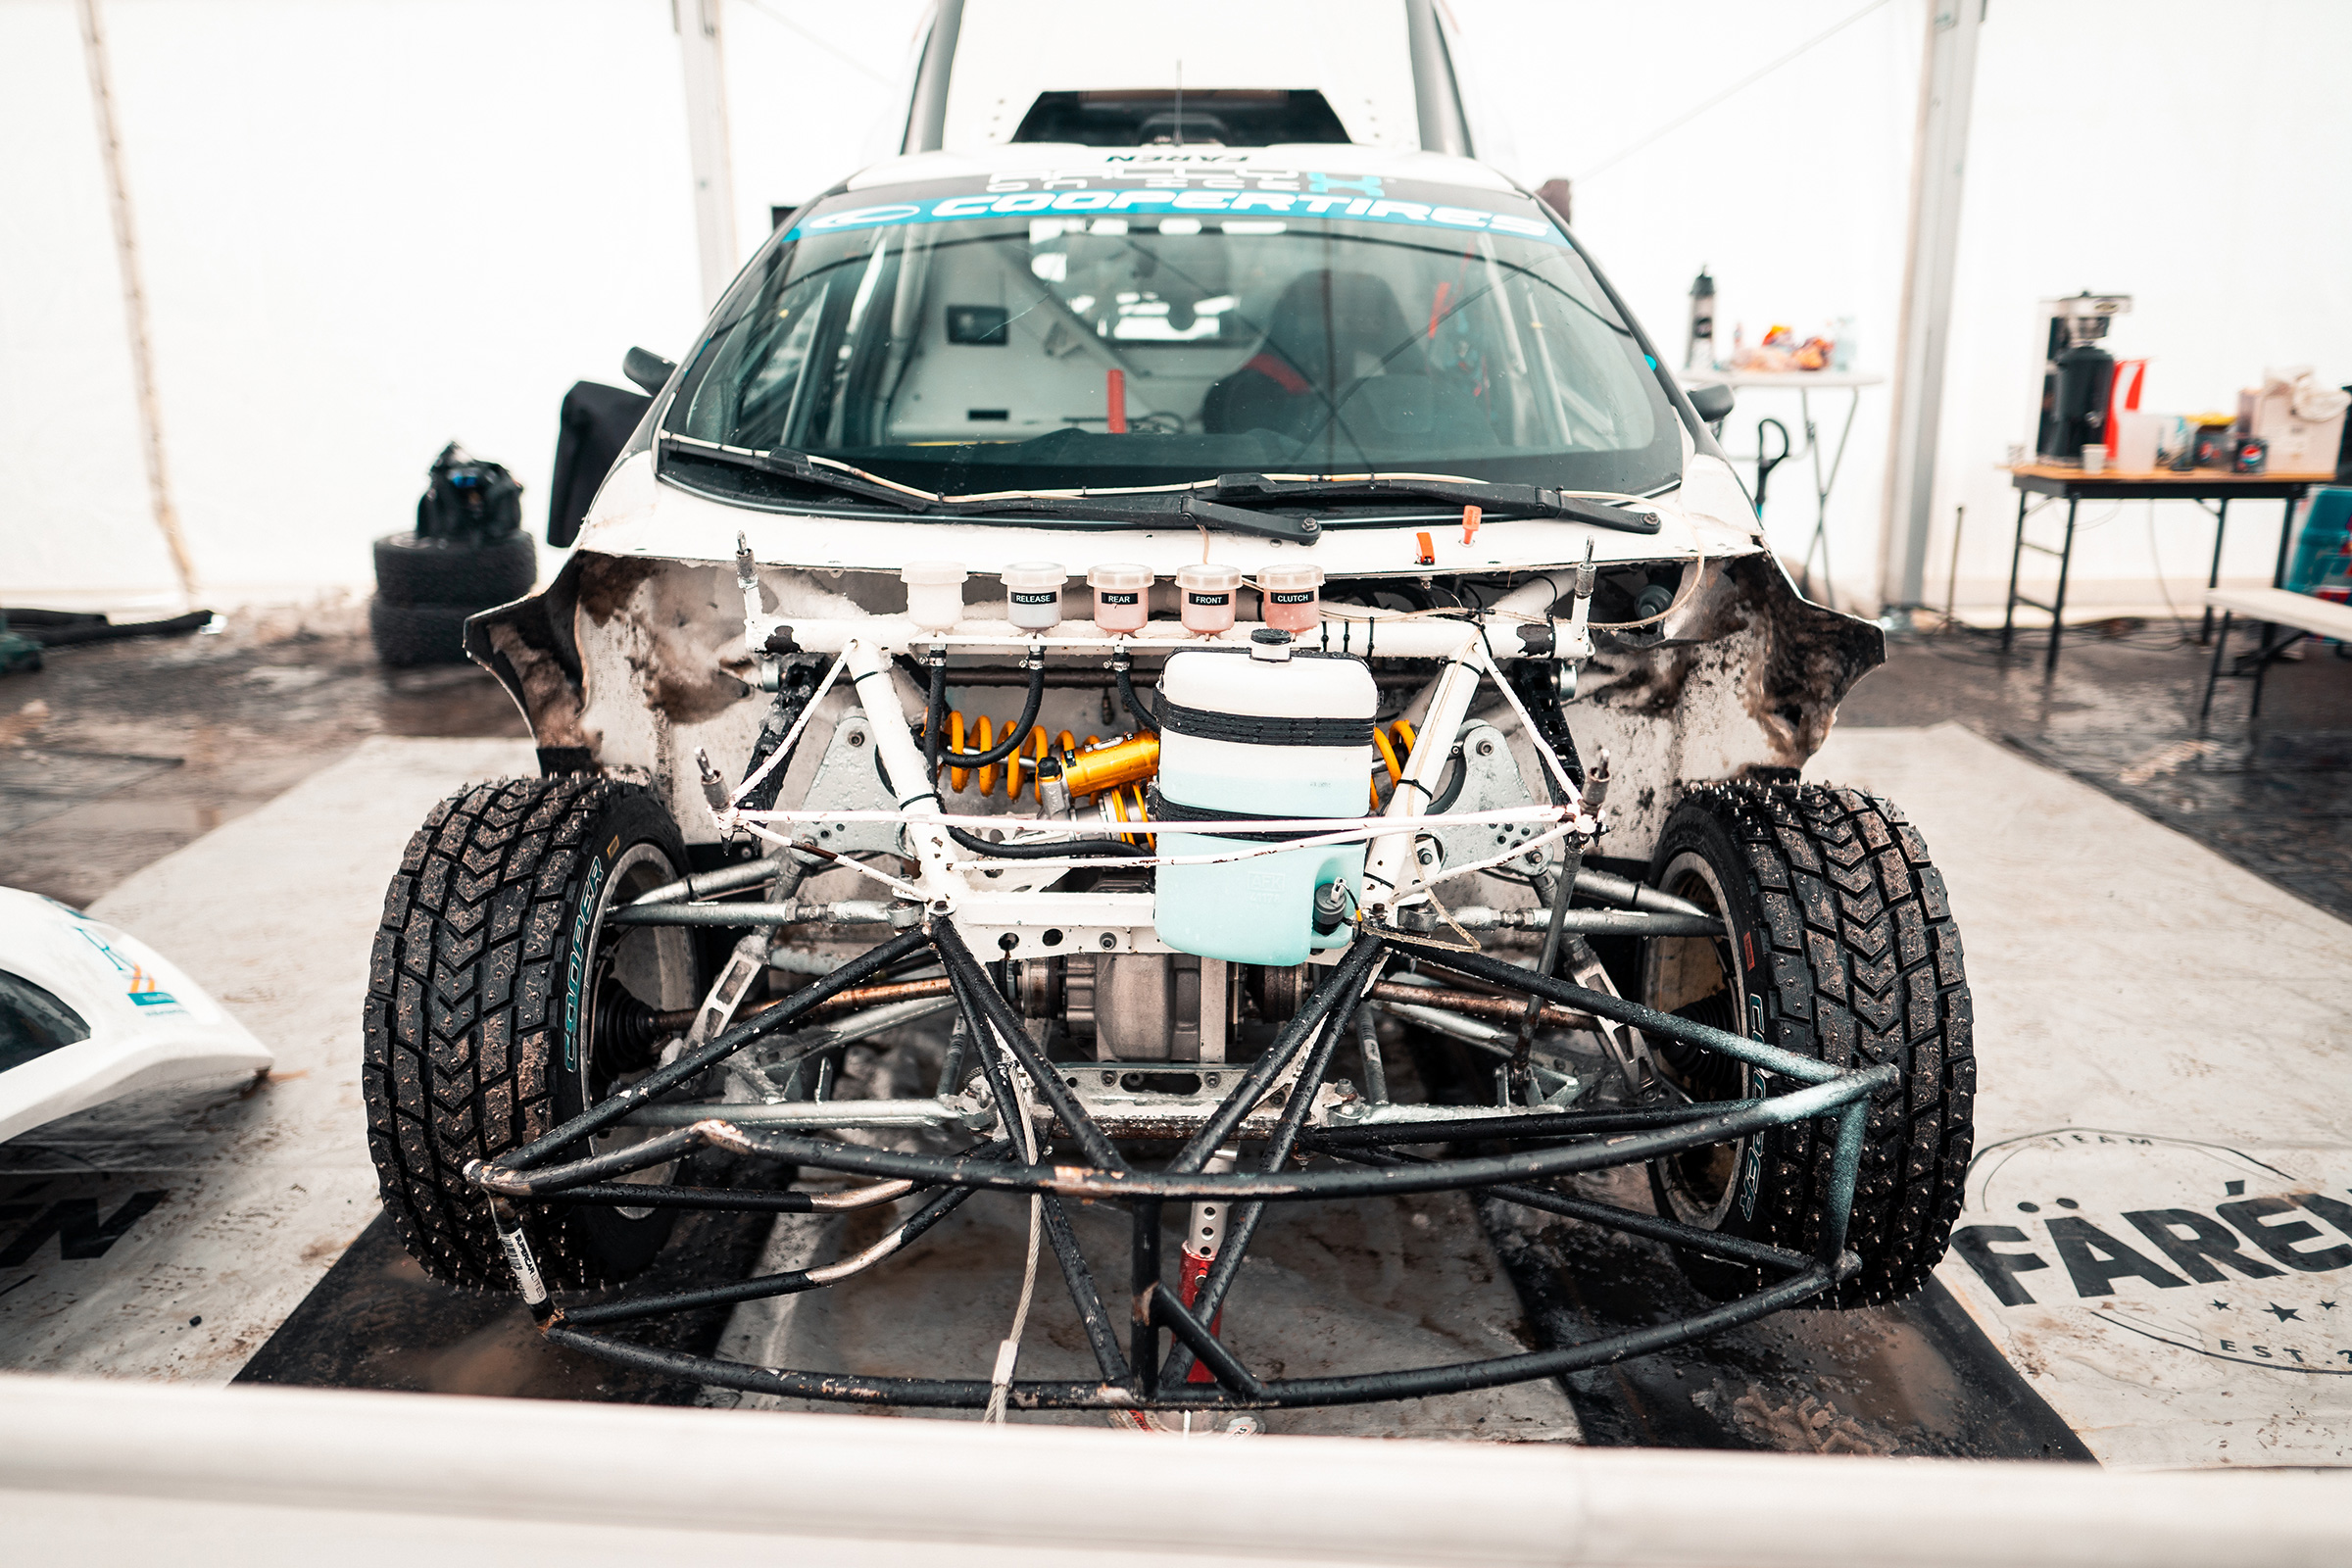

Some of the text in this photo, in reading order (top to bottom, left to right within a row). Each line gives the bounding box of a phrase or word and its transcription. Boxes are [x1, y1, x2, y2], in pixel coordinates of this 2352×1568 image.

[1146, 178, 1300, 190] ICE
[1015, 594, 1052, 603] RELEASE
[1107, 595, 1131, 604] REAR
[1196, 595, 1223, 605] FRONT
[1277, 594, 1308, 603] CLUTCH
[564, 856, 605, 1073] COOPER
[2048, 1134, 2153, 1148] TEAM
[514, 1234, 535, 1274] SUPERCAR
[530, 1272, 546, 1298] LITES
